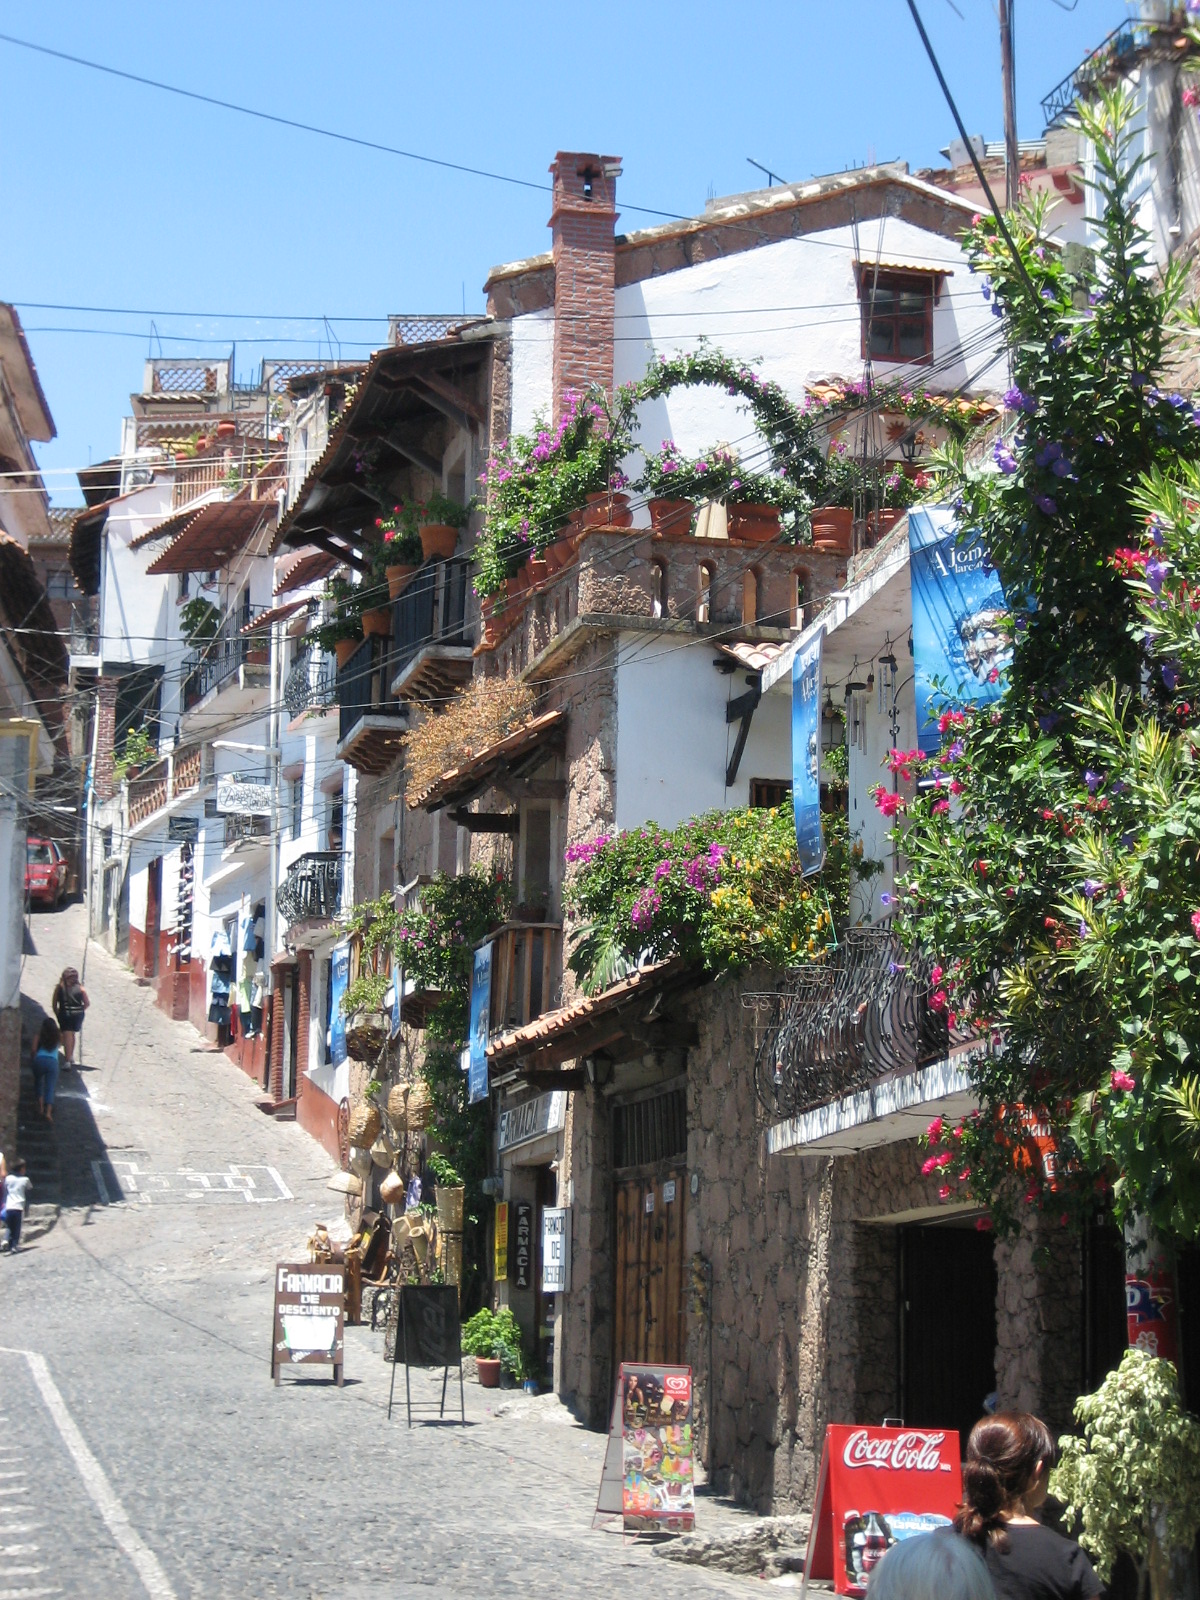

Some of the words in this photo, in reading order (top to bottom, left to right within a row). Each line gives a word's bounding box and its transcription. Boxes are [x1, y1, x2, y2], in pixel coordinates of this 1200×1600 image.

[517, 1205, 530, 1287] FARMACIA
[551, 1240, 560, 1259] DE
[278, 1268, 343, 1293] FARMACIA
[300, 1294, 320, 1304] DE
[278, 1304, 340, 1316] DESCUENTO
